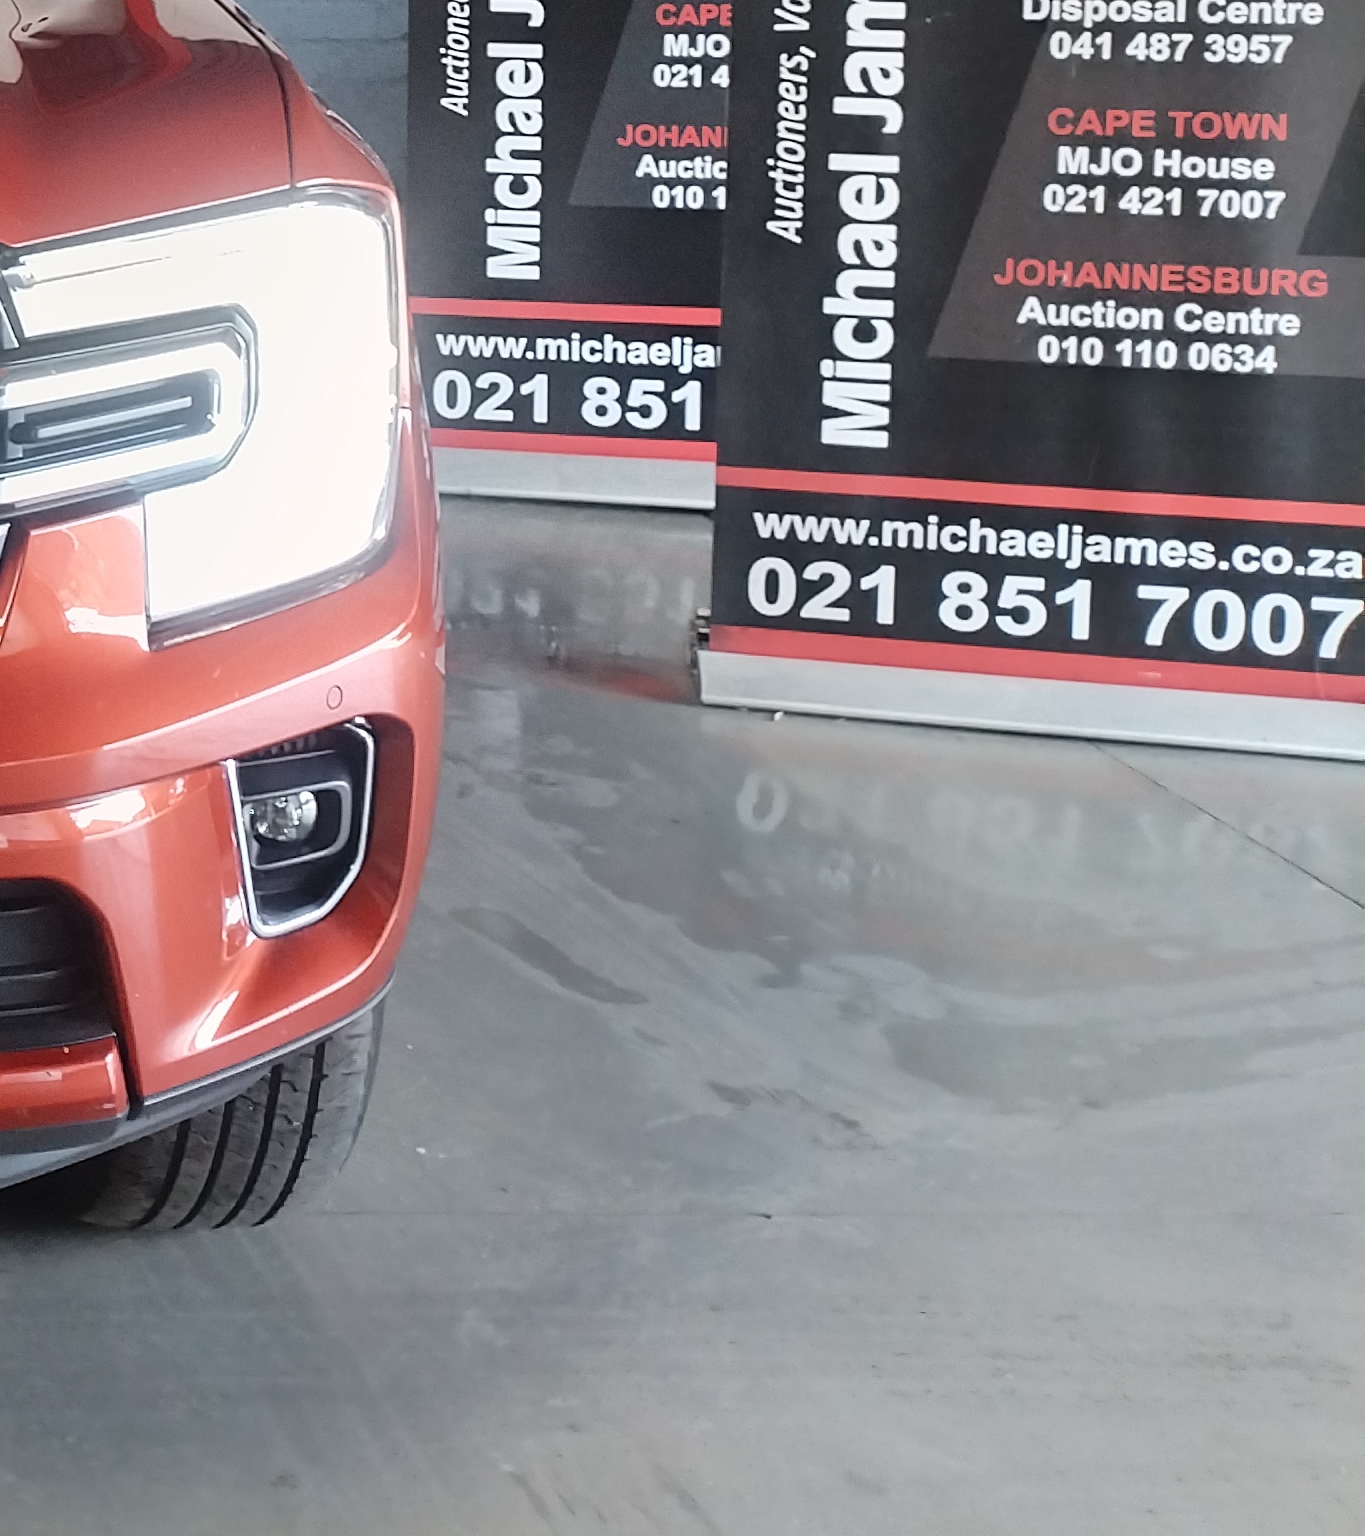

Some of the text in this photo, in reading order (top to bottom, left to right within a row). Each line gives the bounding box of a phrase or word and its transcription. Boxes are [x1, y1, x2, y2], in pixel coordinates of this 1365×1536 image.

[663, 34, 731, 57] MJO
[1049, 30, 1294, 64] 041 487 3957
[653, 64, 703, 88] 021
[765, 45, 817, 244] Auctioneers,
[1047, 107, 1288, 142] CAPE TOWN
[484, 41, 545, 281] Michael
[1057, 145, 1276, 181] MJO House
[652, 185, 704, 210] 010
[1042, 183, 1287, 220] 021 421 7007
[993, 257, 1329, 298] JOHANNESBURG
[821, 153, 900, 449] Michael
[1016, 295, 1301, 337] Auction Centre
[1037, 334, 1279, 375] 010 110 0634
[433, 369, 702, 431] 021 851
[752, 510, 1364, 581] www.michaeljames.co.za
[747, 556, 1365, 659] 021 851 7007
